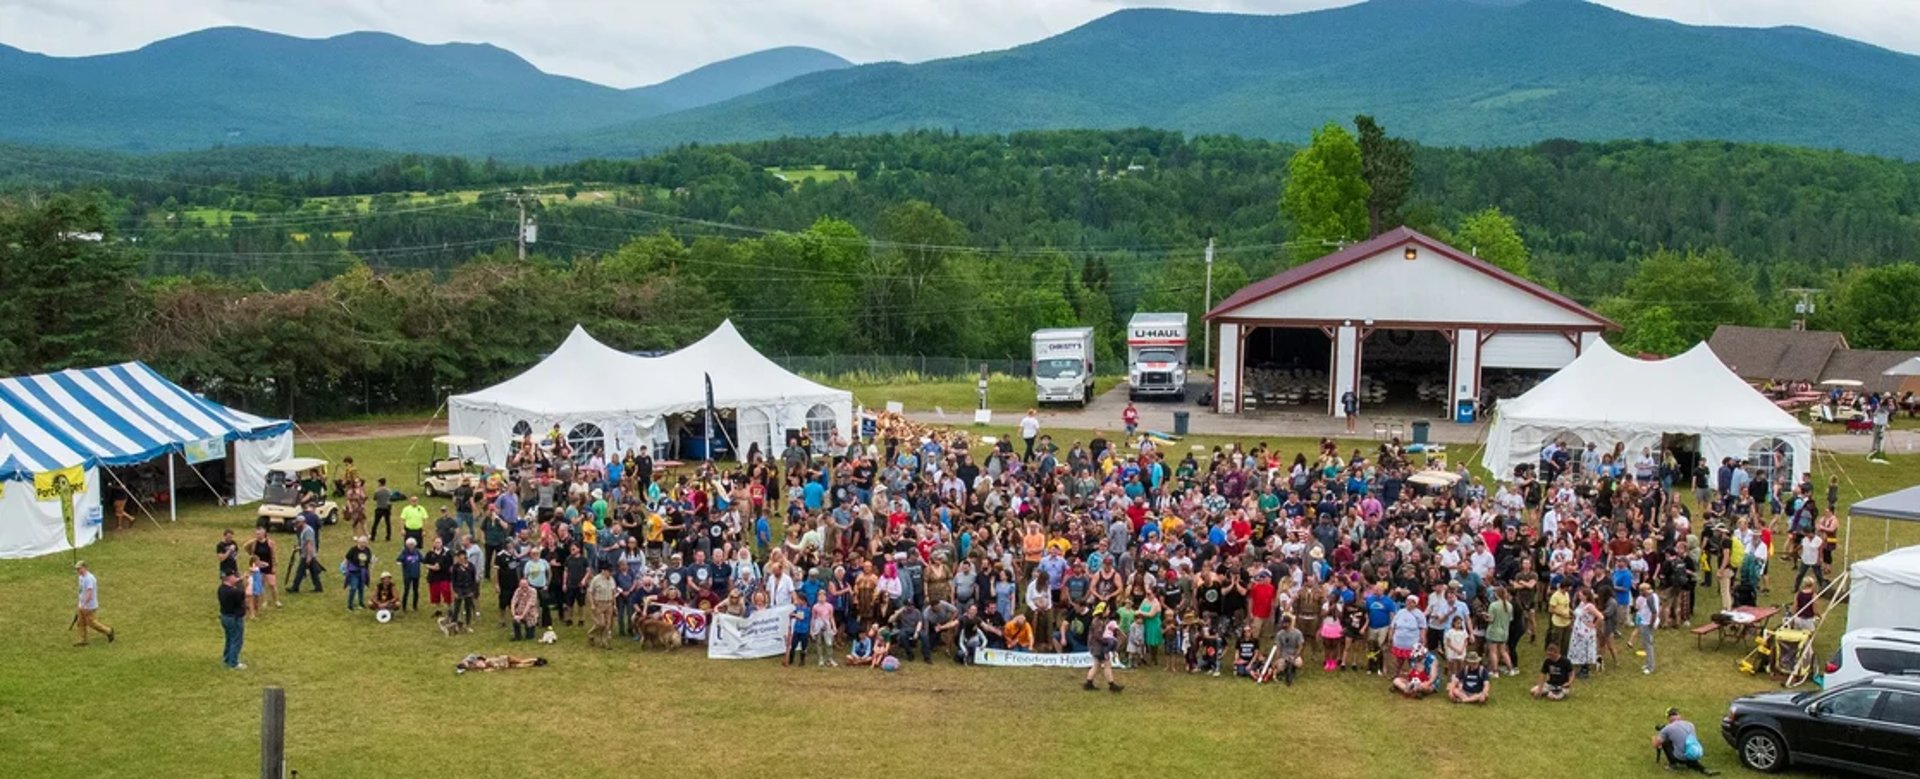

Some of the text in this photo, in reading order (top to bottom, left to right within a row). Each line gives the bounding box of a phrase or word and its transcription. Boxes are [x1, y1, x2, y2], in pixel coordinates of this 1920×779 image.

[1135, 329, 1180, 338] U-HAUL
[1004, 652, 1092, 664] Freedom Have
